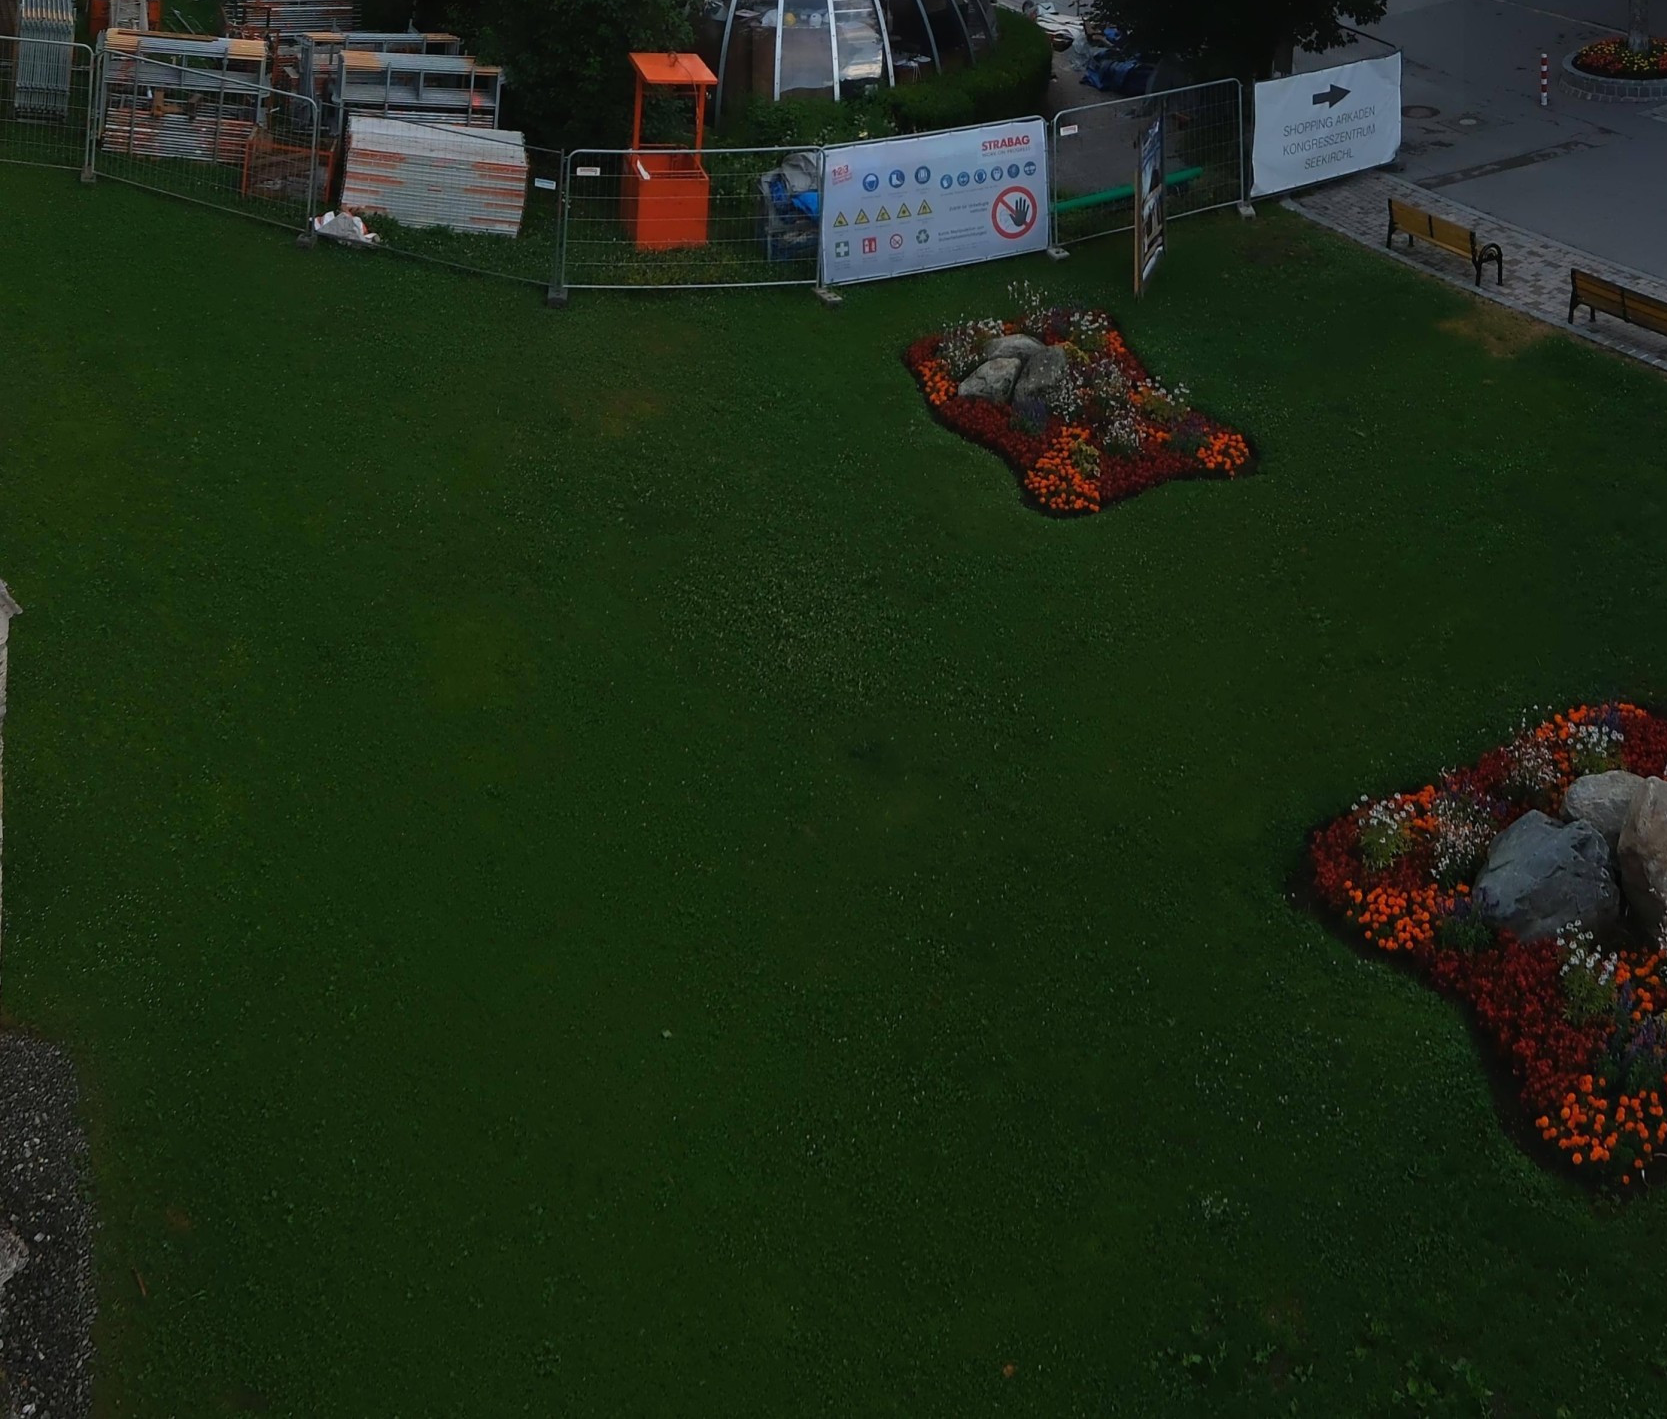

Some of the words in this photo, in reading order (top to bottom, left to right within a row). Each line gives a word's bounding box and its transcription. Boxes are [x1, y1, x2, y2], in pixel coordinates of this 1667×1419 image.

[1283, 117, 1333, 137] SHOPPING
[1335, 106, 1376, 126] ARKADEN
[982, 135, 1030, 152] STRABAG
[1282, 124, 1376, 156] KONGRESSZENTRUM
[1304, 148, 1354, 170] SEEKIRCHL
